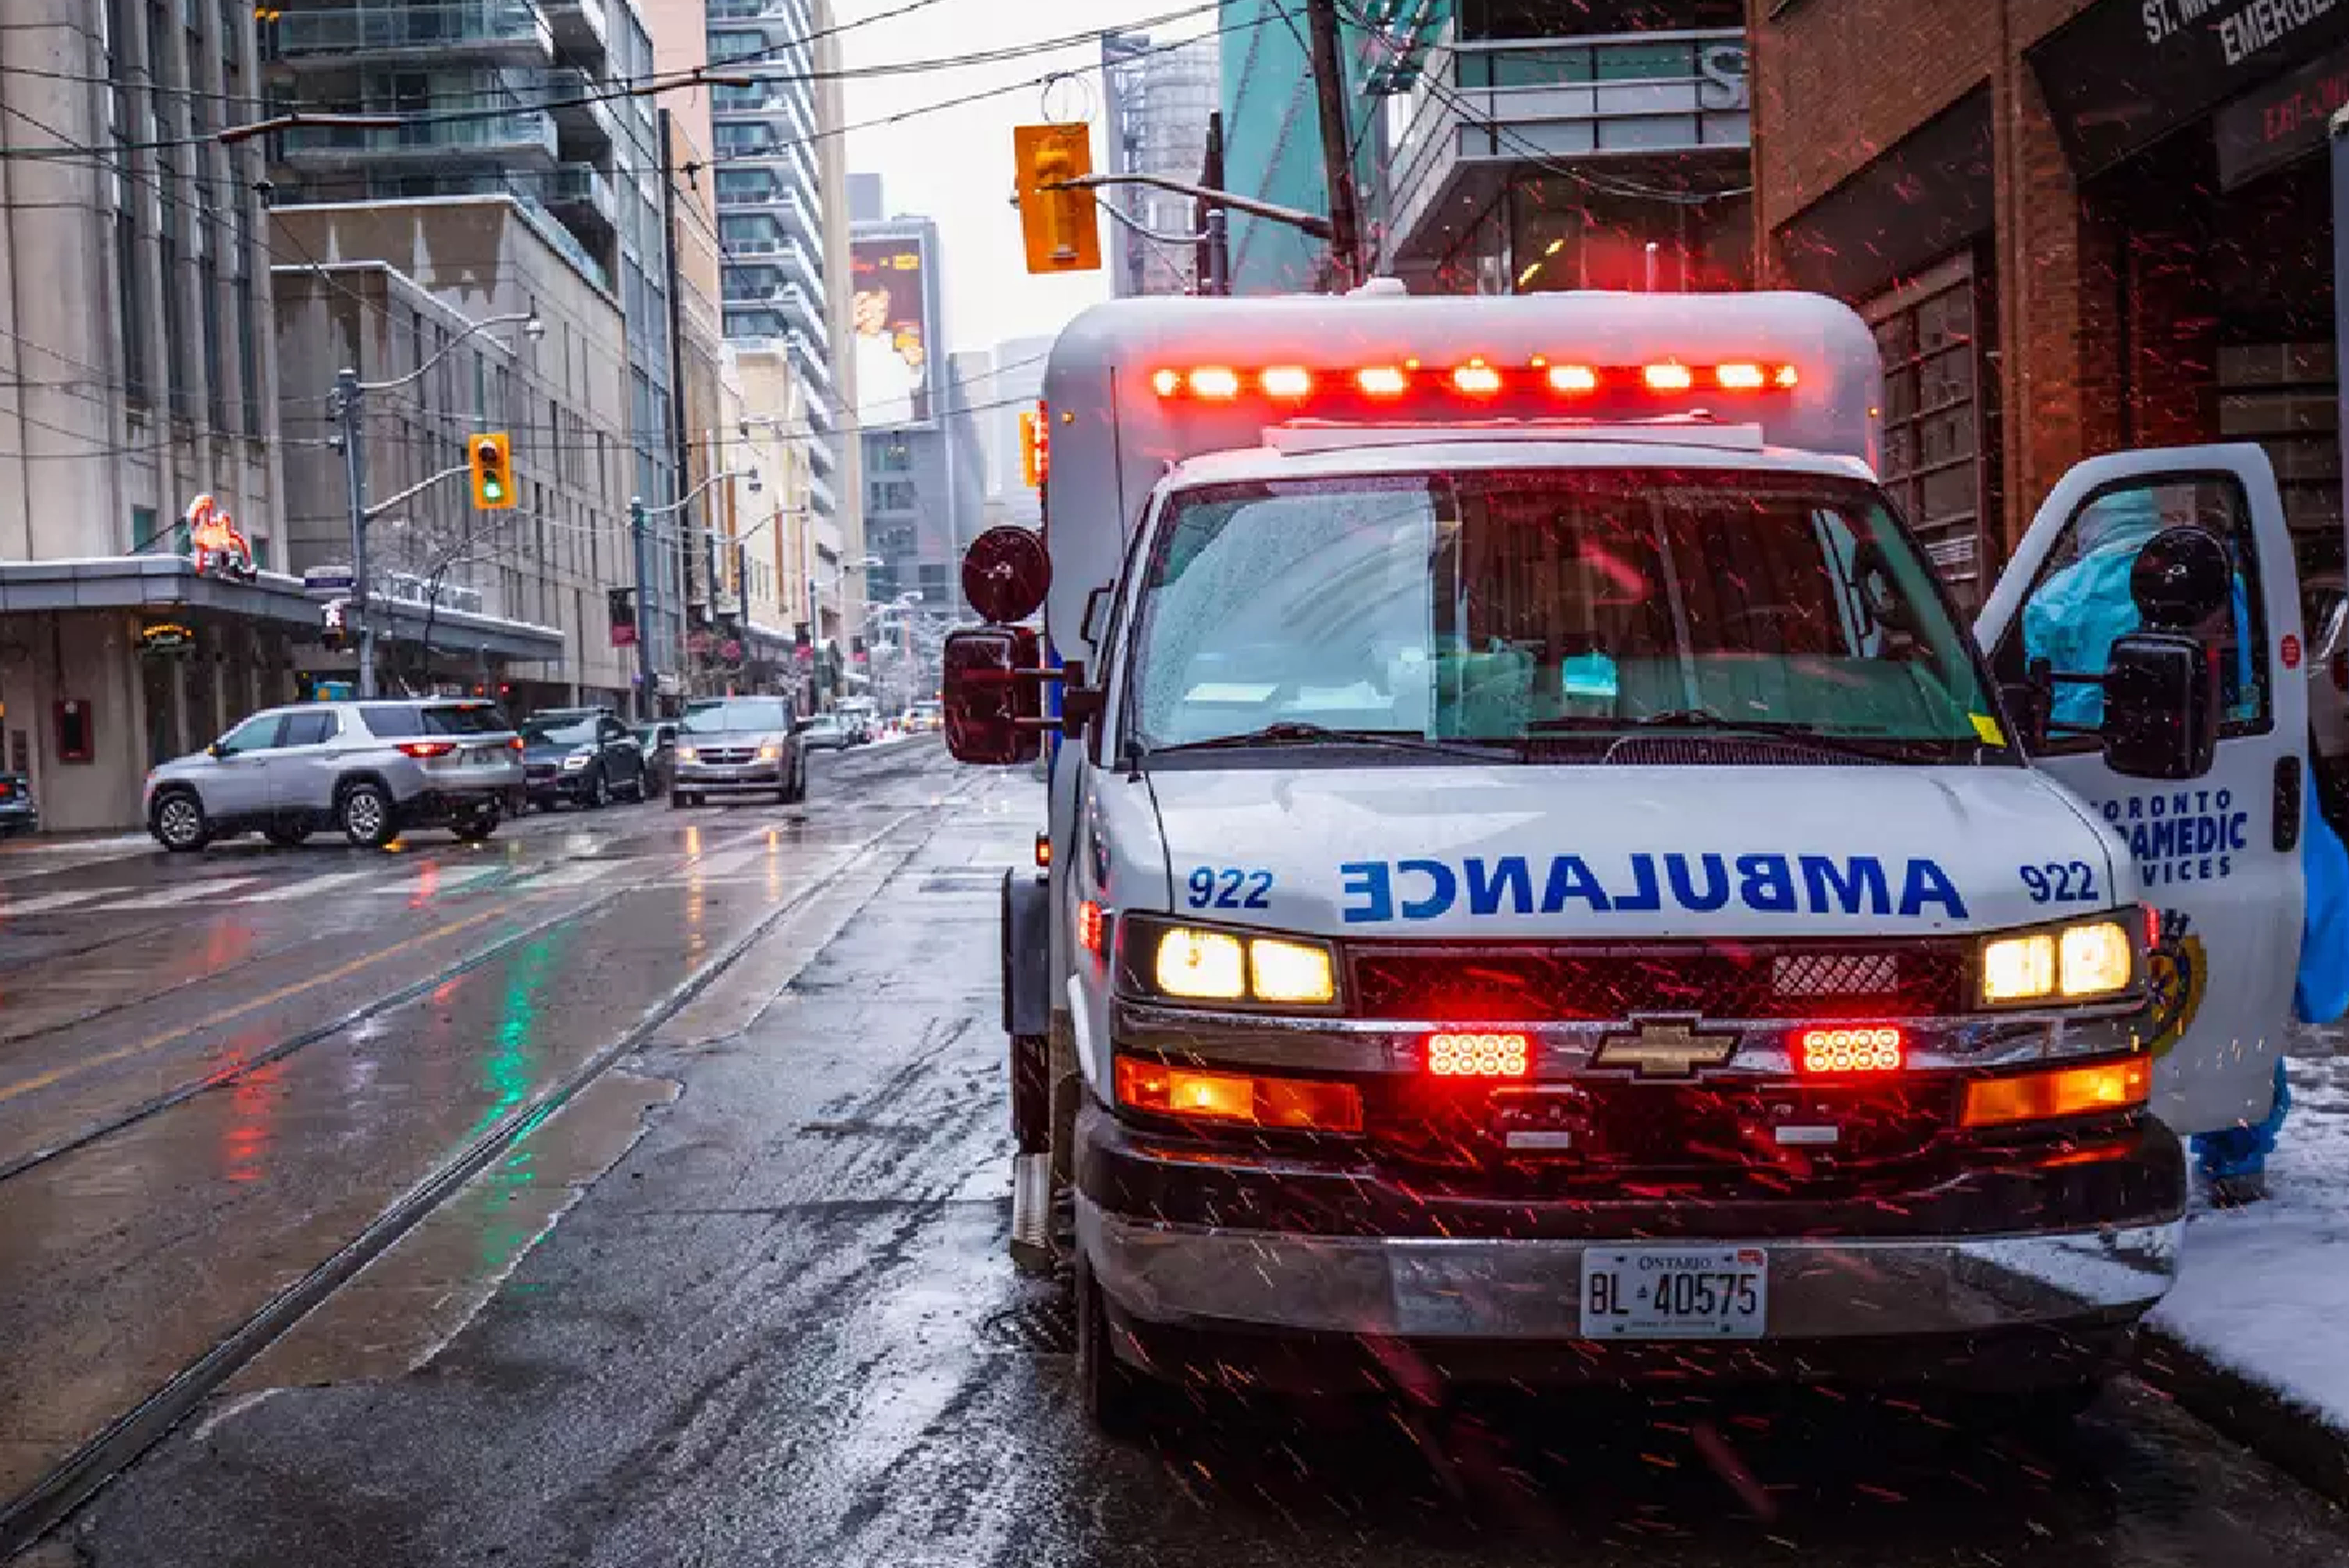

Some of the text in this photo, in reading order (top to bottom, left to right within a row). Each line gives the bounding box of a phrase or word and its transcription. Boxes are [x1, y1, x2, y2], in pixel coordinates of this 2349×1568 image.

[1189, 866, 1273, 908] 922
[2020, 861, 2099, 902] 922
[1640, 1257, 1711, 1270] ONTARIO
[1589, 1274, 1756, 1315] BL 40575
